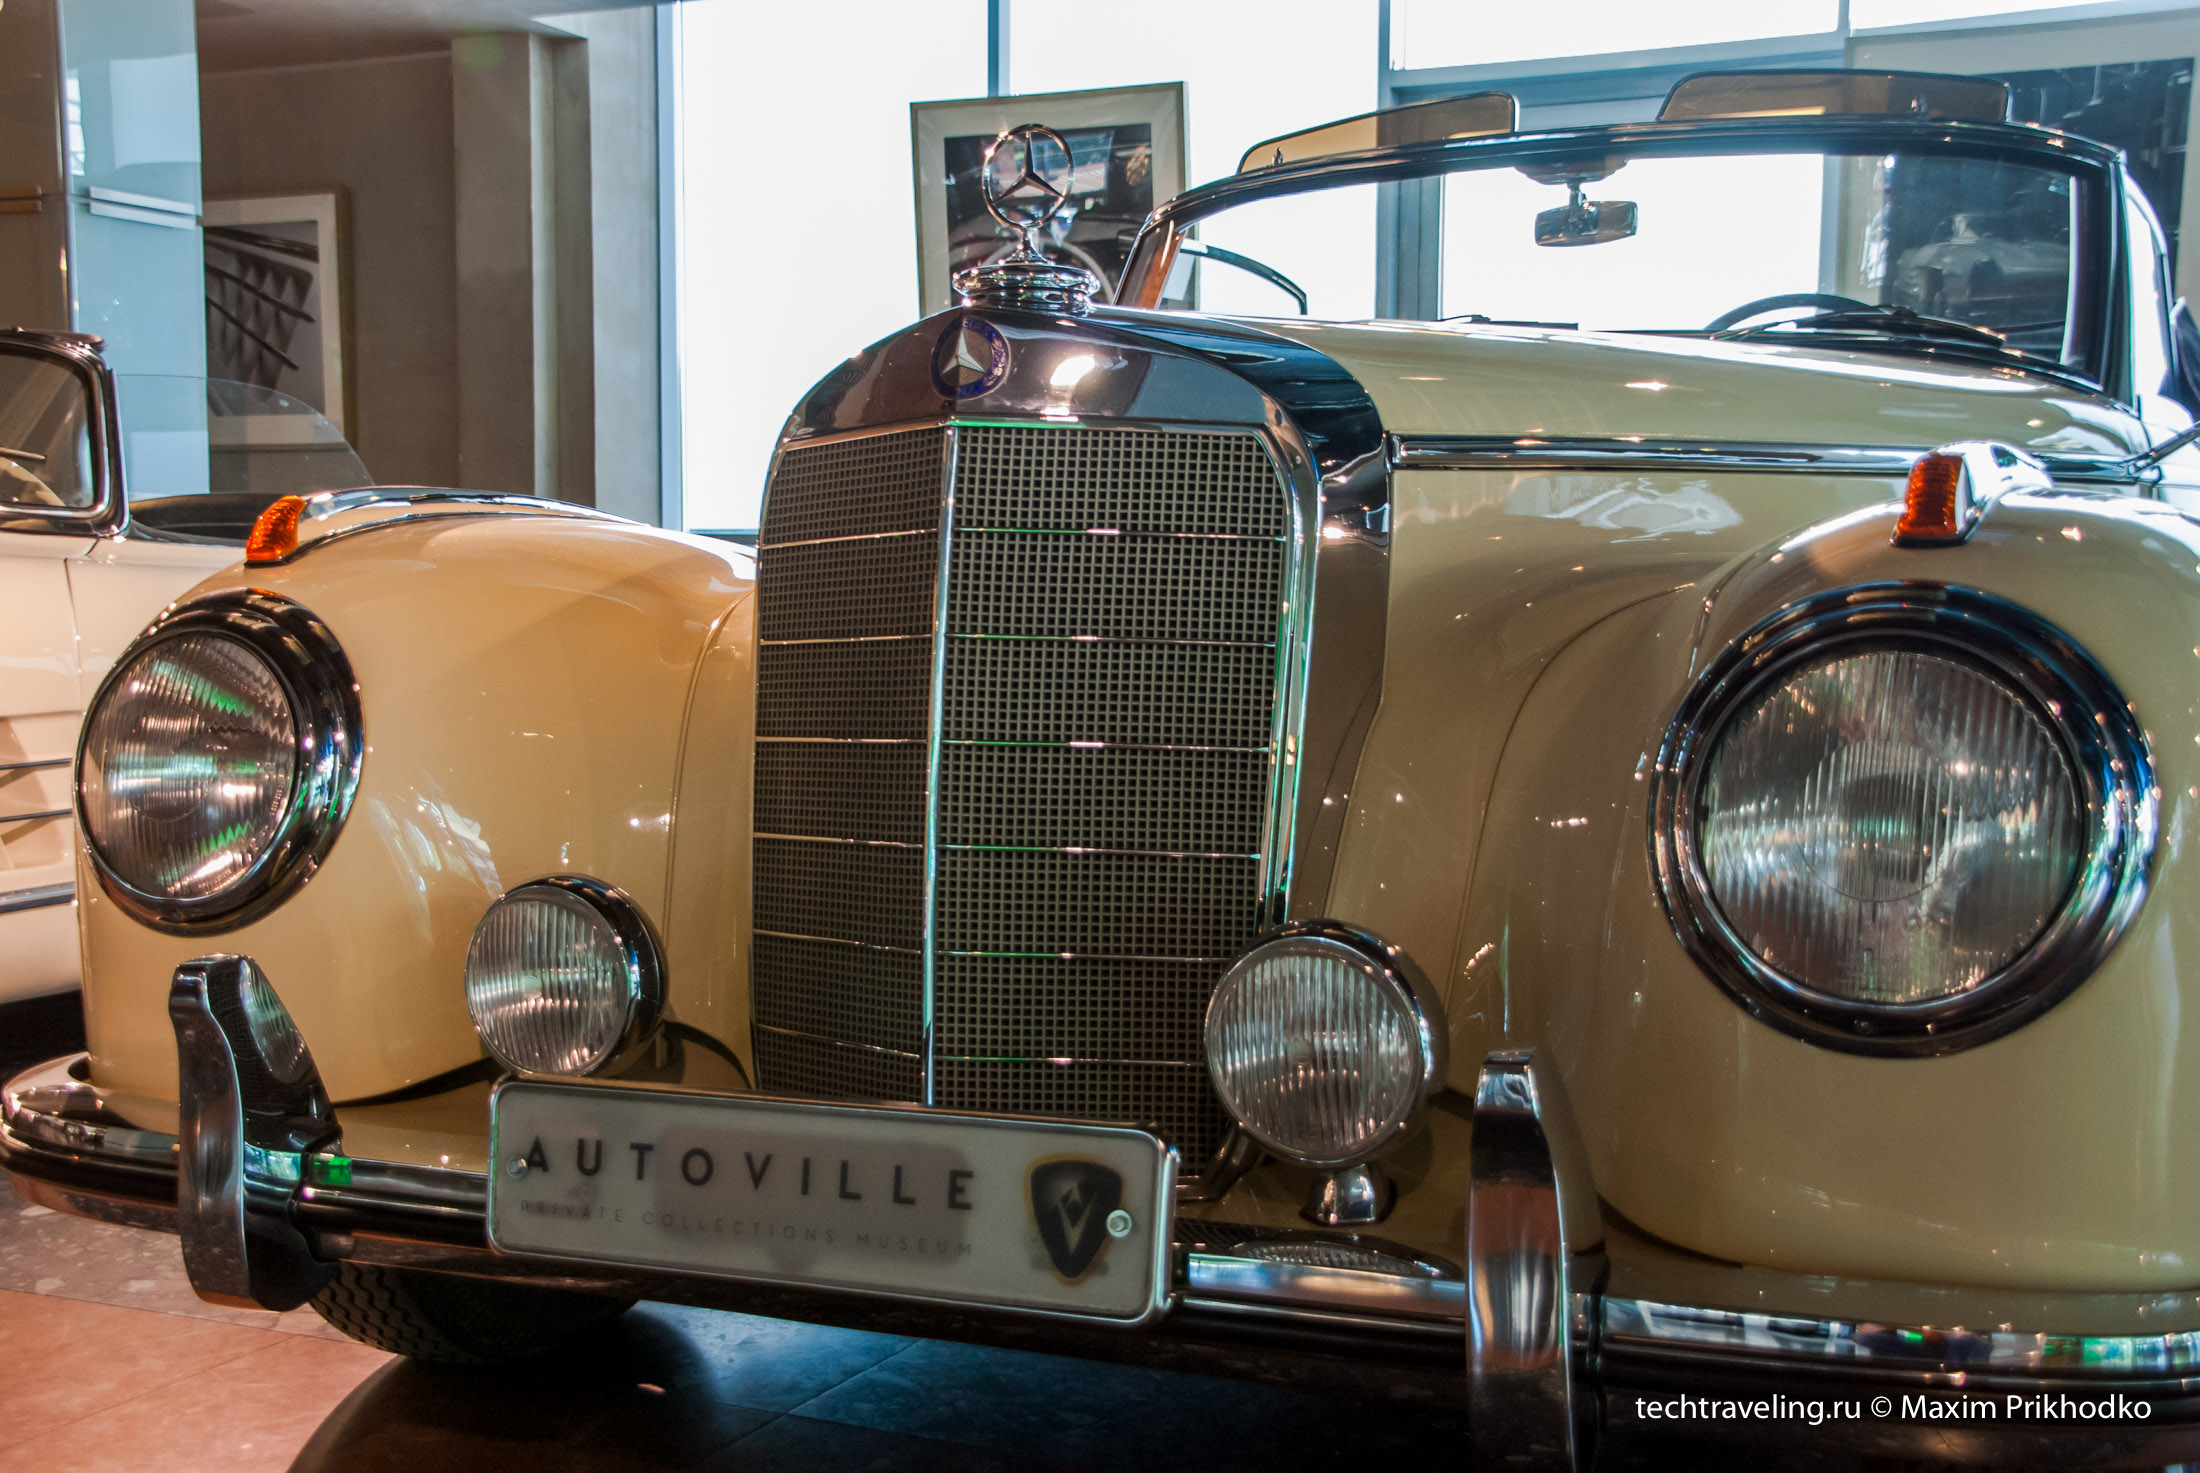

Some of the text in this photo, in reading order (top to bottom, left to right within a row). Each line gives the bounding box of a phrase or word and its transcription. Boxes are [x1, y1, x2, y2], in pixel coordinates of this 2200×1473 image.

[527, 1135, 974, 1210] AUTOVILLE
[520, 1199, 972, 1256] PRIVATE COLLECTIONS MUSEUM
